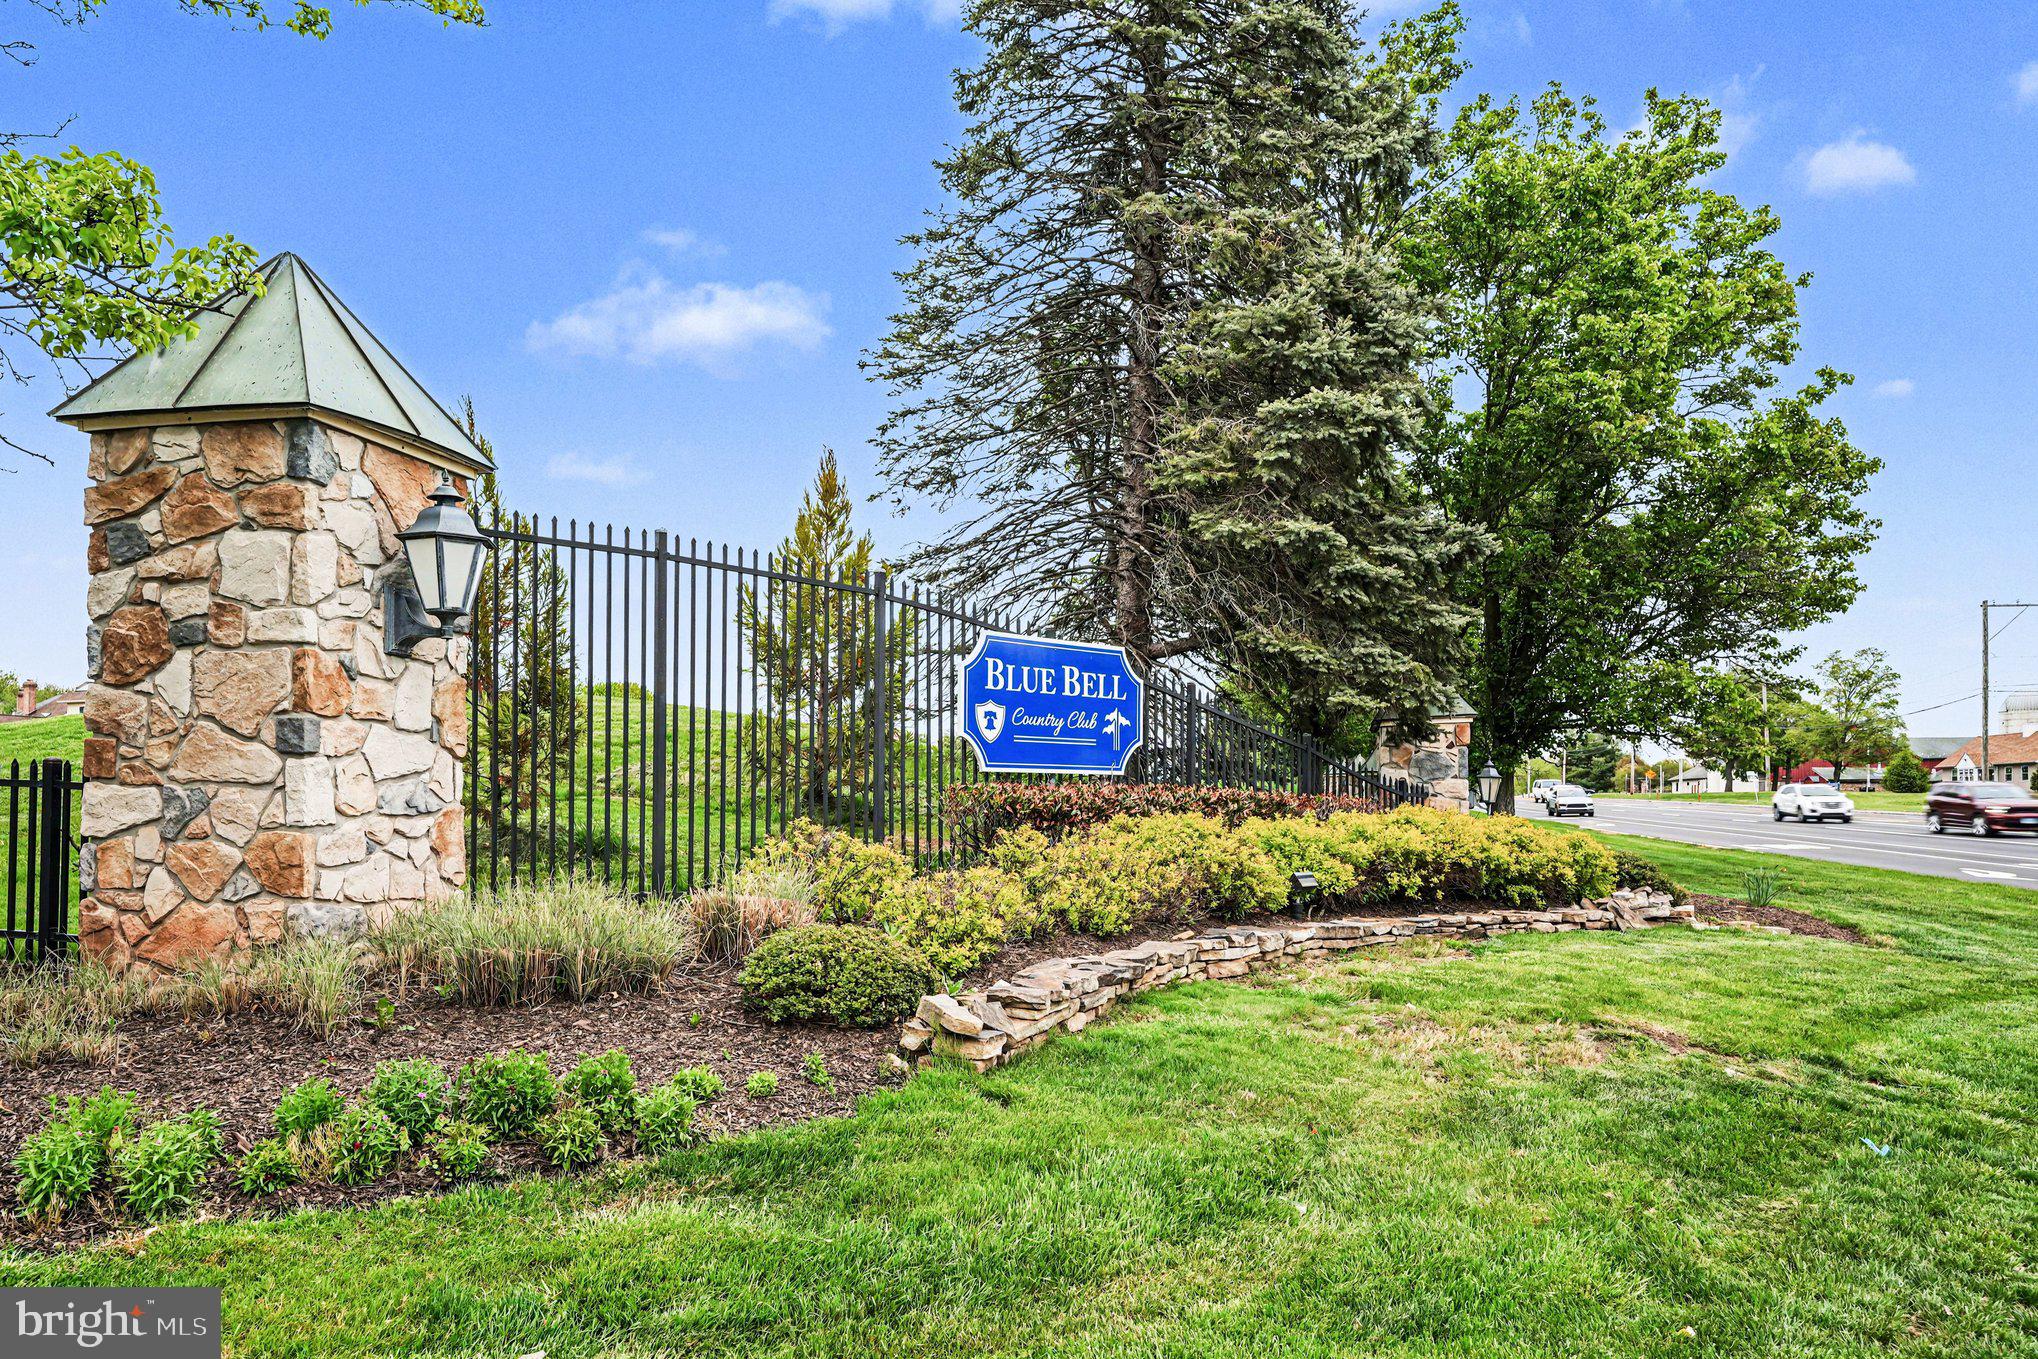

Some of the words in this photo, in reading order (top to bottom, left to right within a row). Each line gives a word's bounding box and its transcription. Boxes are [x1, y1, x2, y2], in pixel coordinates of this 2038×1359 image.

[985, 657, 1056, 695] BLUE
[1062, 665, 1127, 700] BELL
[1011, 707, 1064, 736] Country
[1067, 711, 1098, 730] Club
